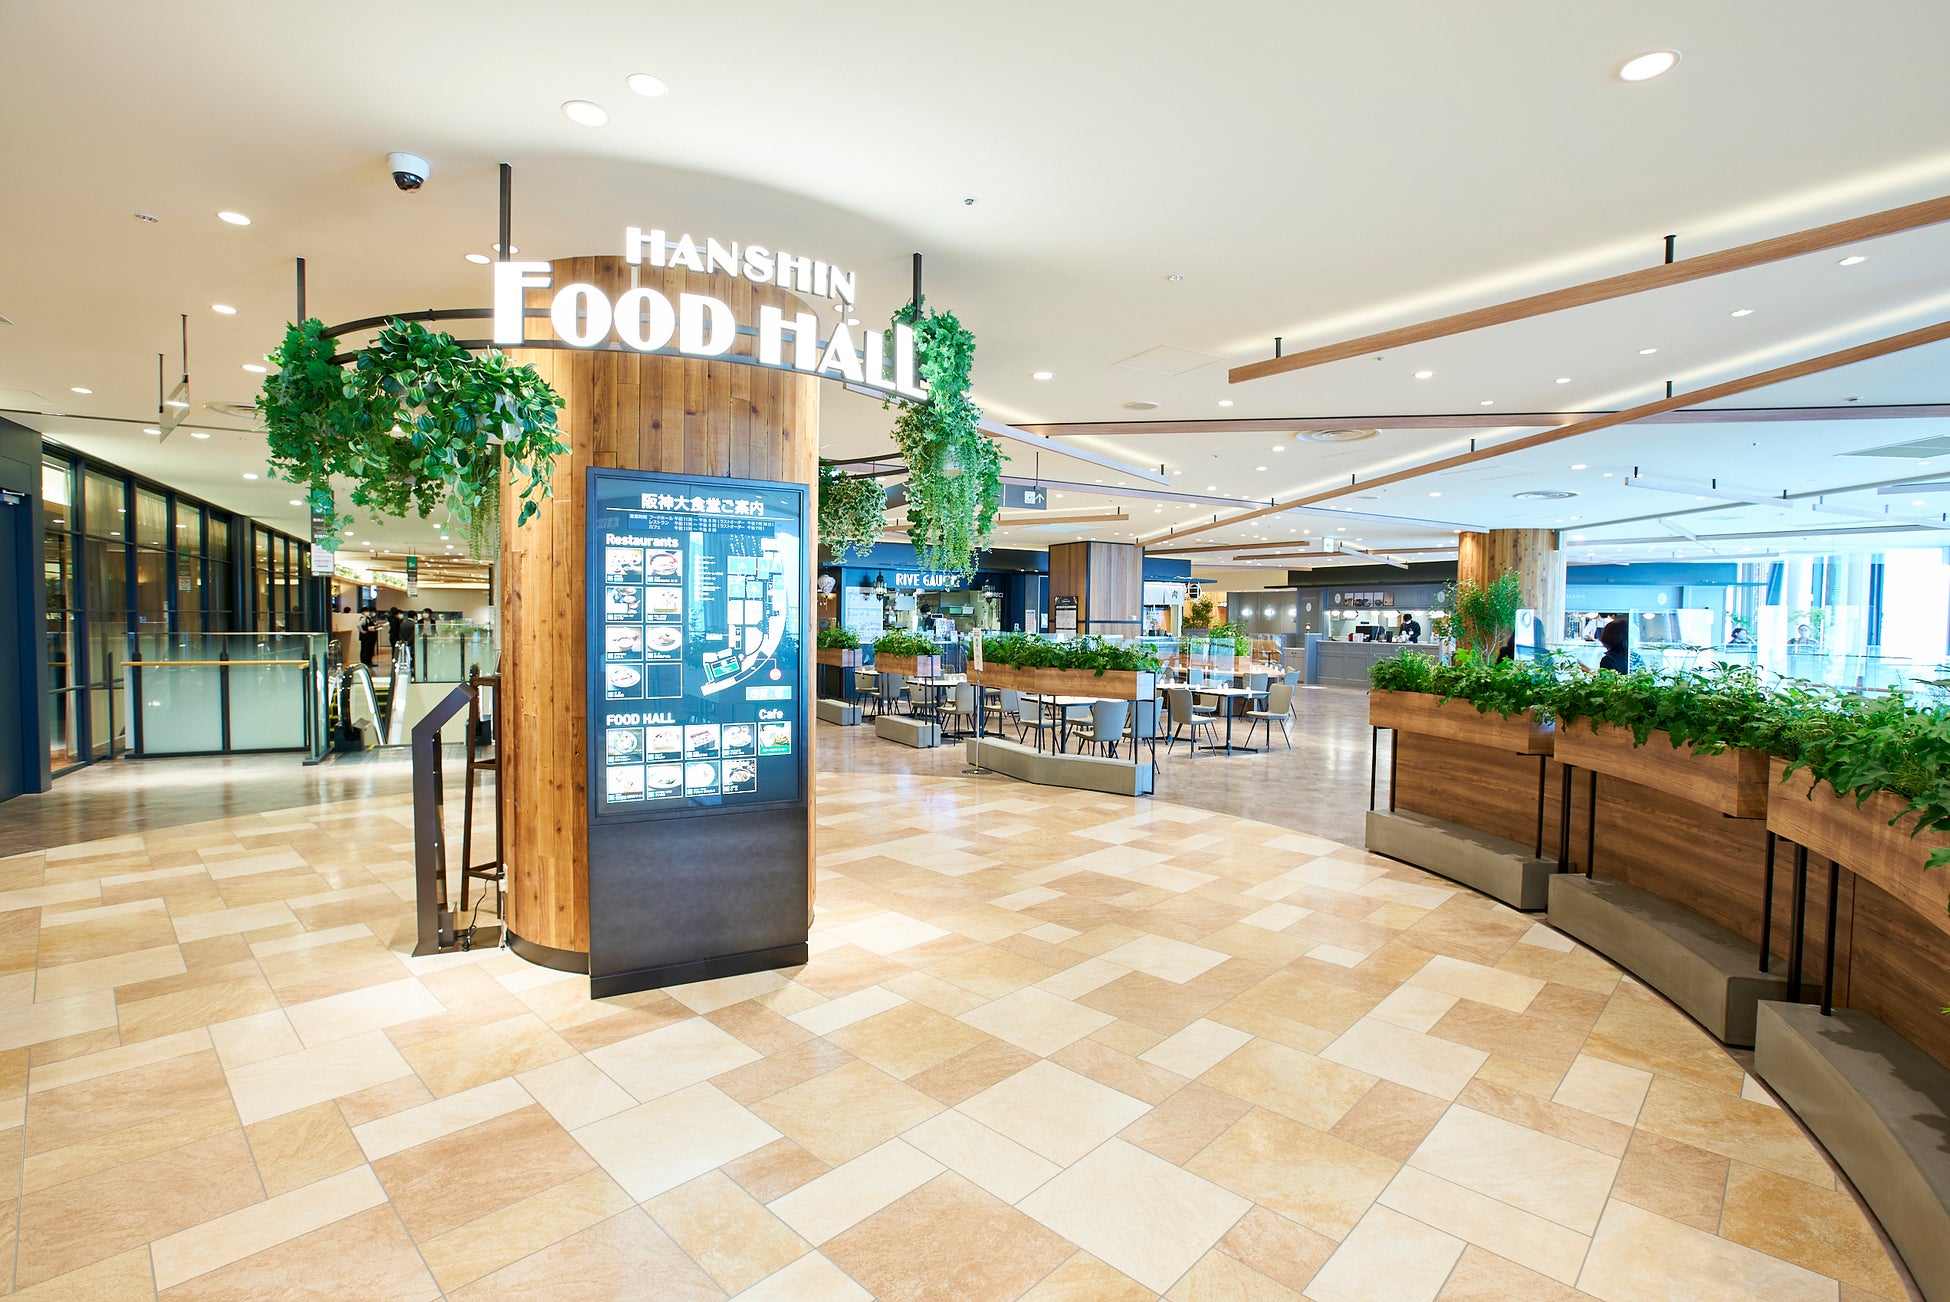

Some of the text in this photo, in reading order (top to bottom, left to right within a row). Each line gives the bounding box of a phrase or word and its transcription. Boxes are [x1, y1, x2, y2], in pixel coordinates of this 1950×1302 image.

[626, 226, 856, 305] HANSHIN
[493, 261, 928, 400] FOOD HALL
[641, 492, 764, 516] 阪神大食堂ご案内
[605, 532, 679, 548] Restaurants
[895, 572, 920, 586] RIVE
[606, 712, 676, 726] FOOD HALL
[758, 708, 784, 720] Cafe
